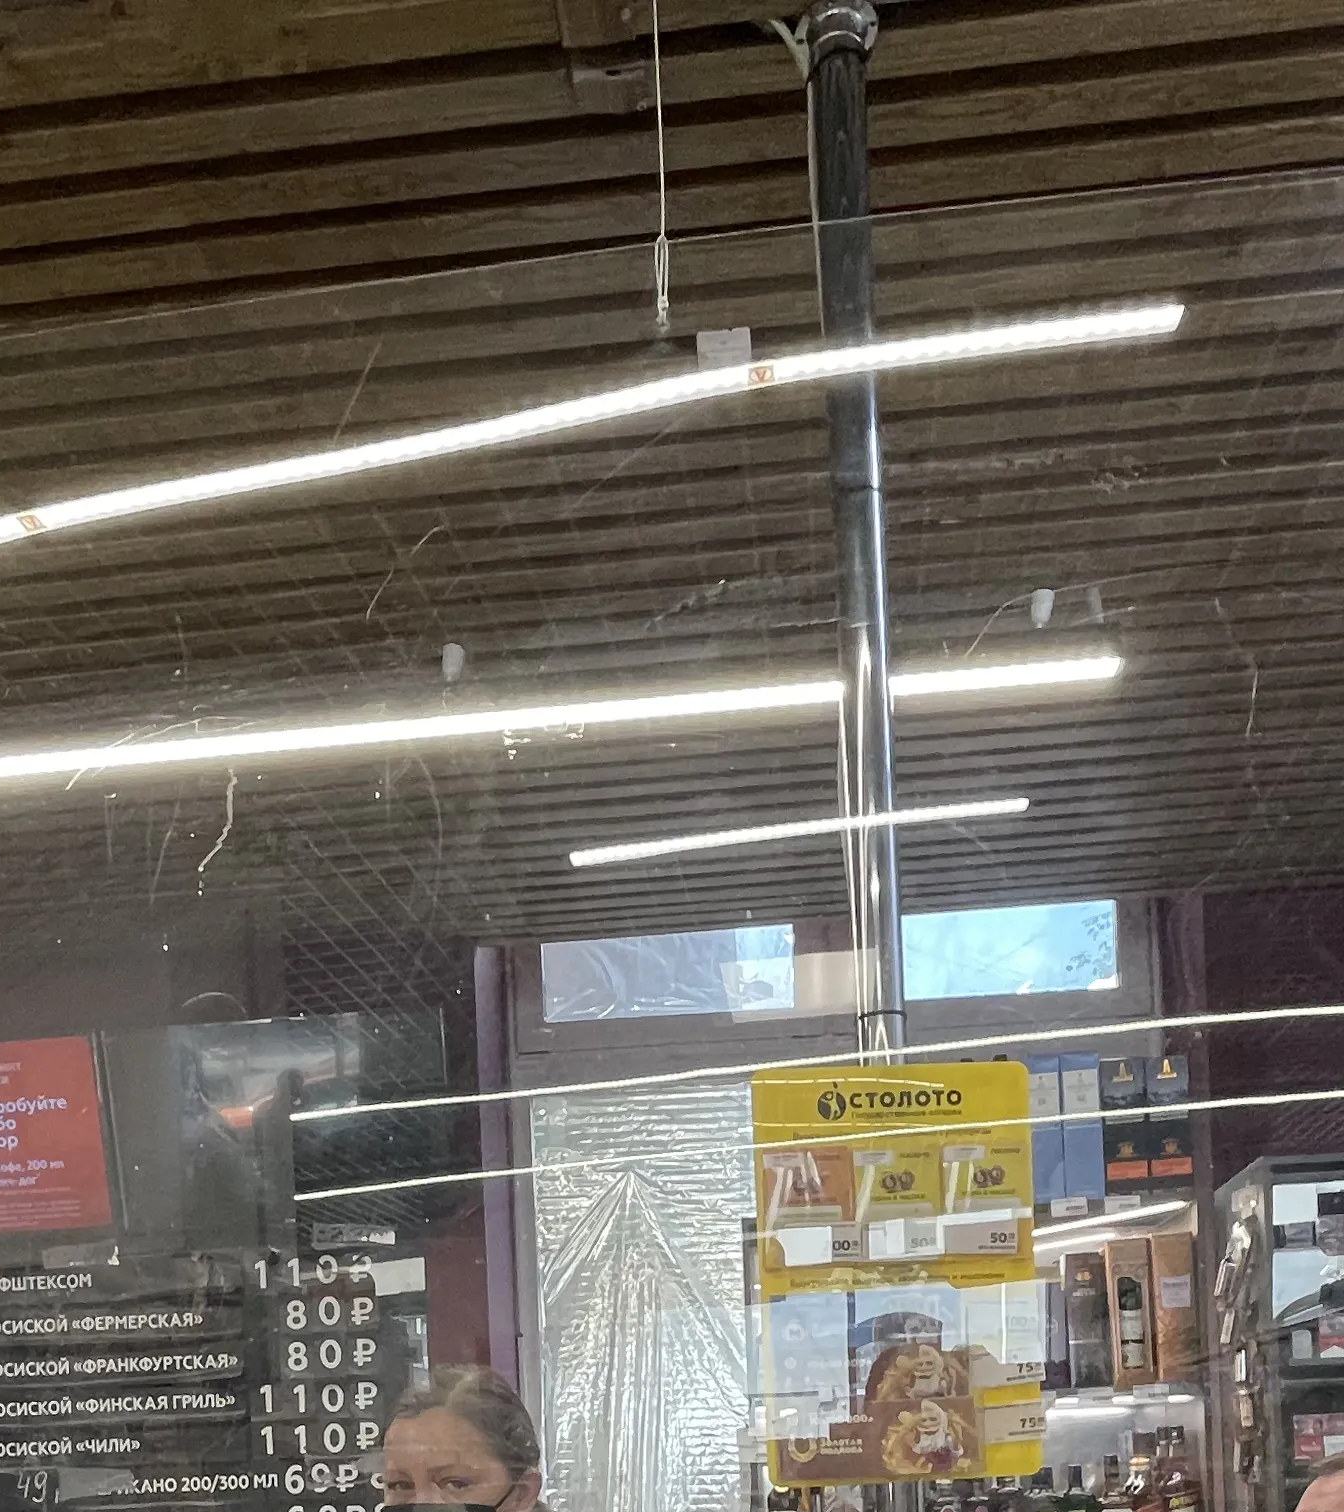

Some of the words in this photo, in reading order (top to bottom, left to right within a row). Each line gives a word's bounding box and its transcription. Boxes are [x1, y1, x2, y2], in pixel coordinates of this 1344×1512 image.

[850, 1090, 962, 1109] СТОЛОТО
[72, 1312, 203, 1331] «ФЕРМЕРСКАЯ»
[74, 1353, 238, 1375] «ФРАНКФУРТСКАЯ»
[76, 1396, 168, 1414] «ФИНСКАЯ
[172, 1394, 235, 1410] ГРИЛЬ»
[76, 1438, 140, 1454] «ЧИЛИ»
[181, 1474, 249, 1496] 200/300
[254, 1474, 278, 1489] МЛ
